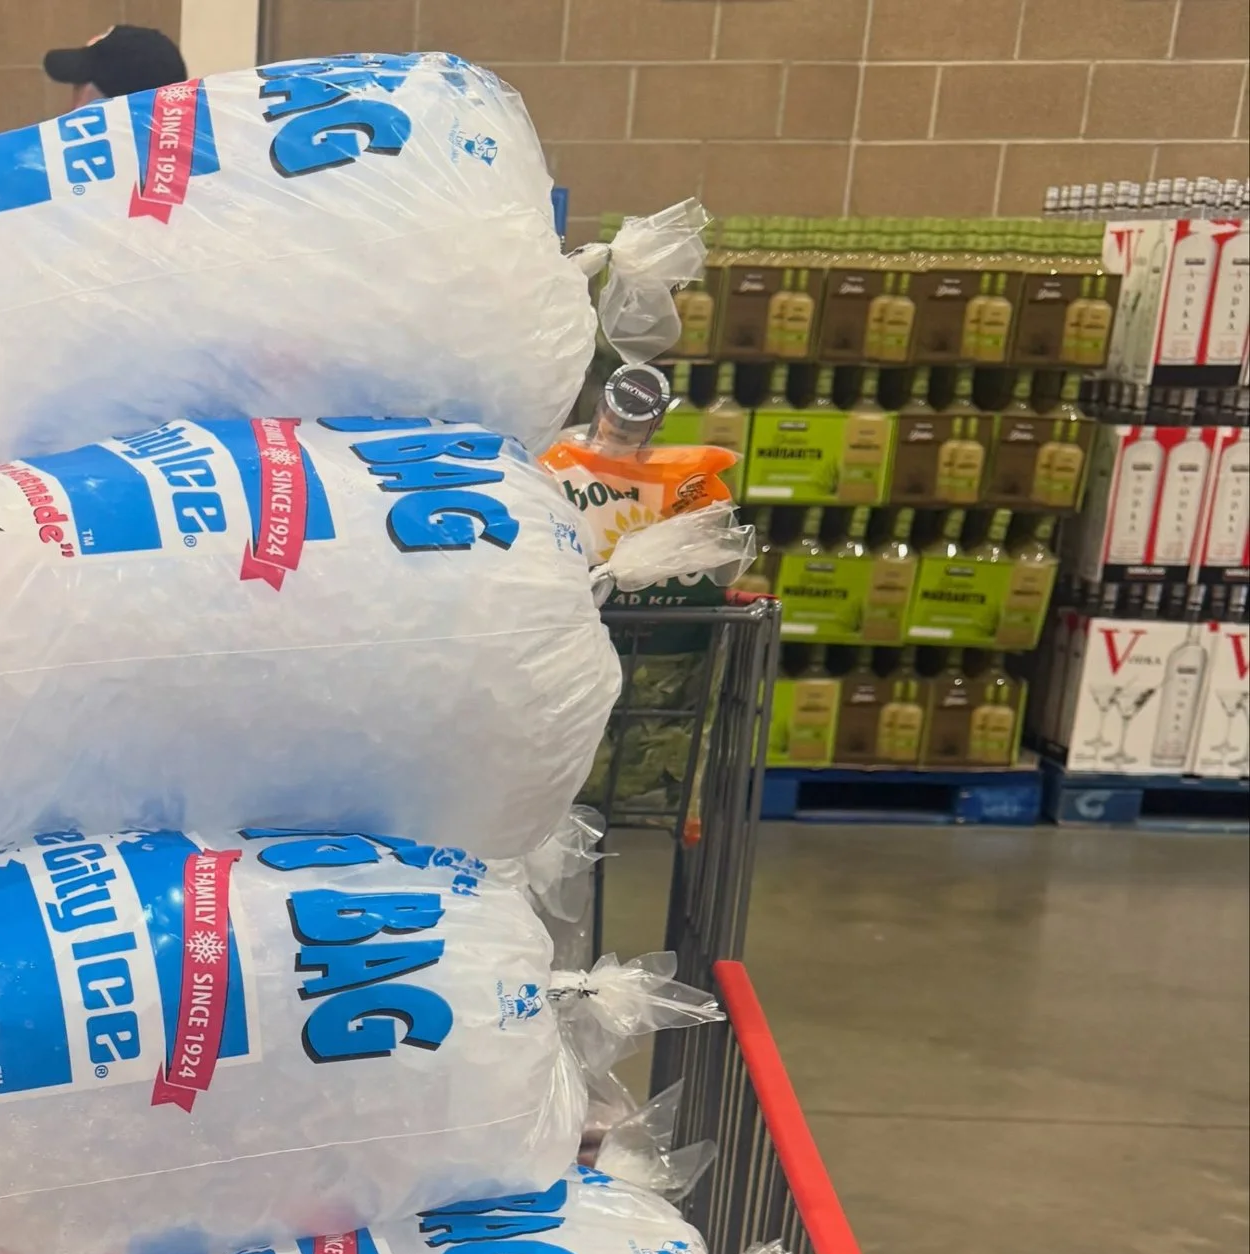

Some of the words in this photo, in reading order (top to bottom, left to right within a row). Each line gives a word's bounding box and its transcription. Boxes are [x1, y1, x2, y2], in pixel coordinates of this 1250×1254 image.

[56, 97, 115, 184] ce
[158, 106, 183, 151] SINCE
[152, 153, 178, 195] 1924
[150, 447, 227, 533] Ice
[270, 469, 293, 513] SINCE
[349, 431, 519, 552] BAG
[265, 515, 289, 556] 1924
[187, 872, 217, 926] FAMILY
[71, 932, 141, 1064] Ice
[187, 972, 214, 1028] SINCE
[286, 888, 454, 1064] BAG
[178, 1031, 205, 1079] 1924
